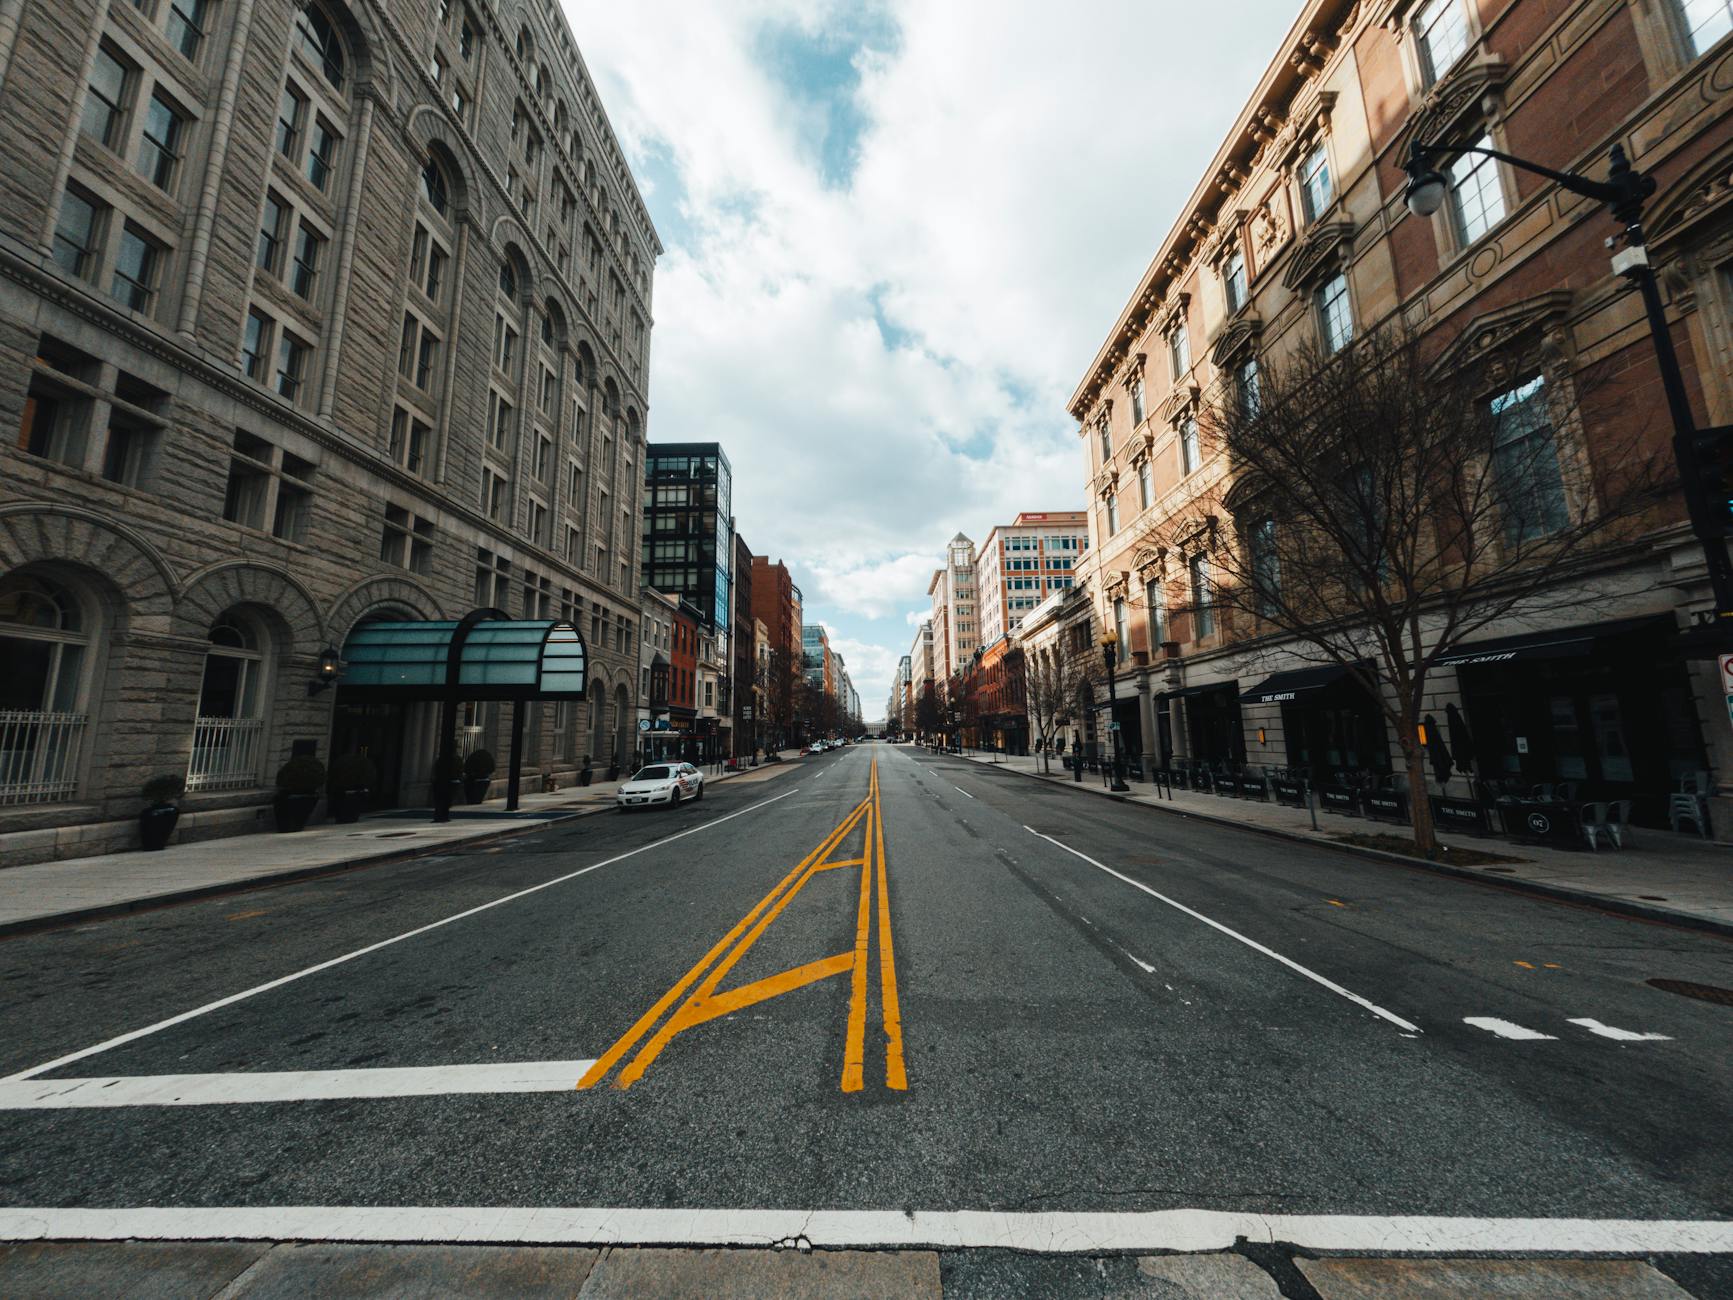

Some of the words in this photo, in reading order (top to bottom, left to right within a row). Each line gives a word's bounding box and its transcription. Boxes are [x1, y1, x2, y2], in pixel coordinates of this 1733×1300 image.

[1470, 652, 1517, 663] SMITH
[1274, 692, 1296, 701] SMITH
[1441, 807, 1455, 815] THE
[1456, 809, 1476, 817] SMITH
